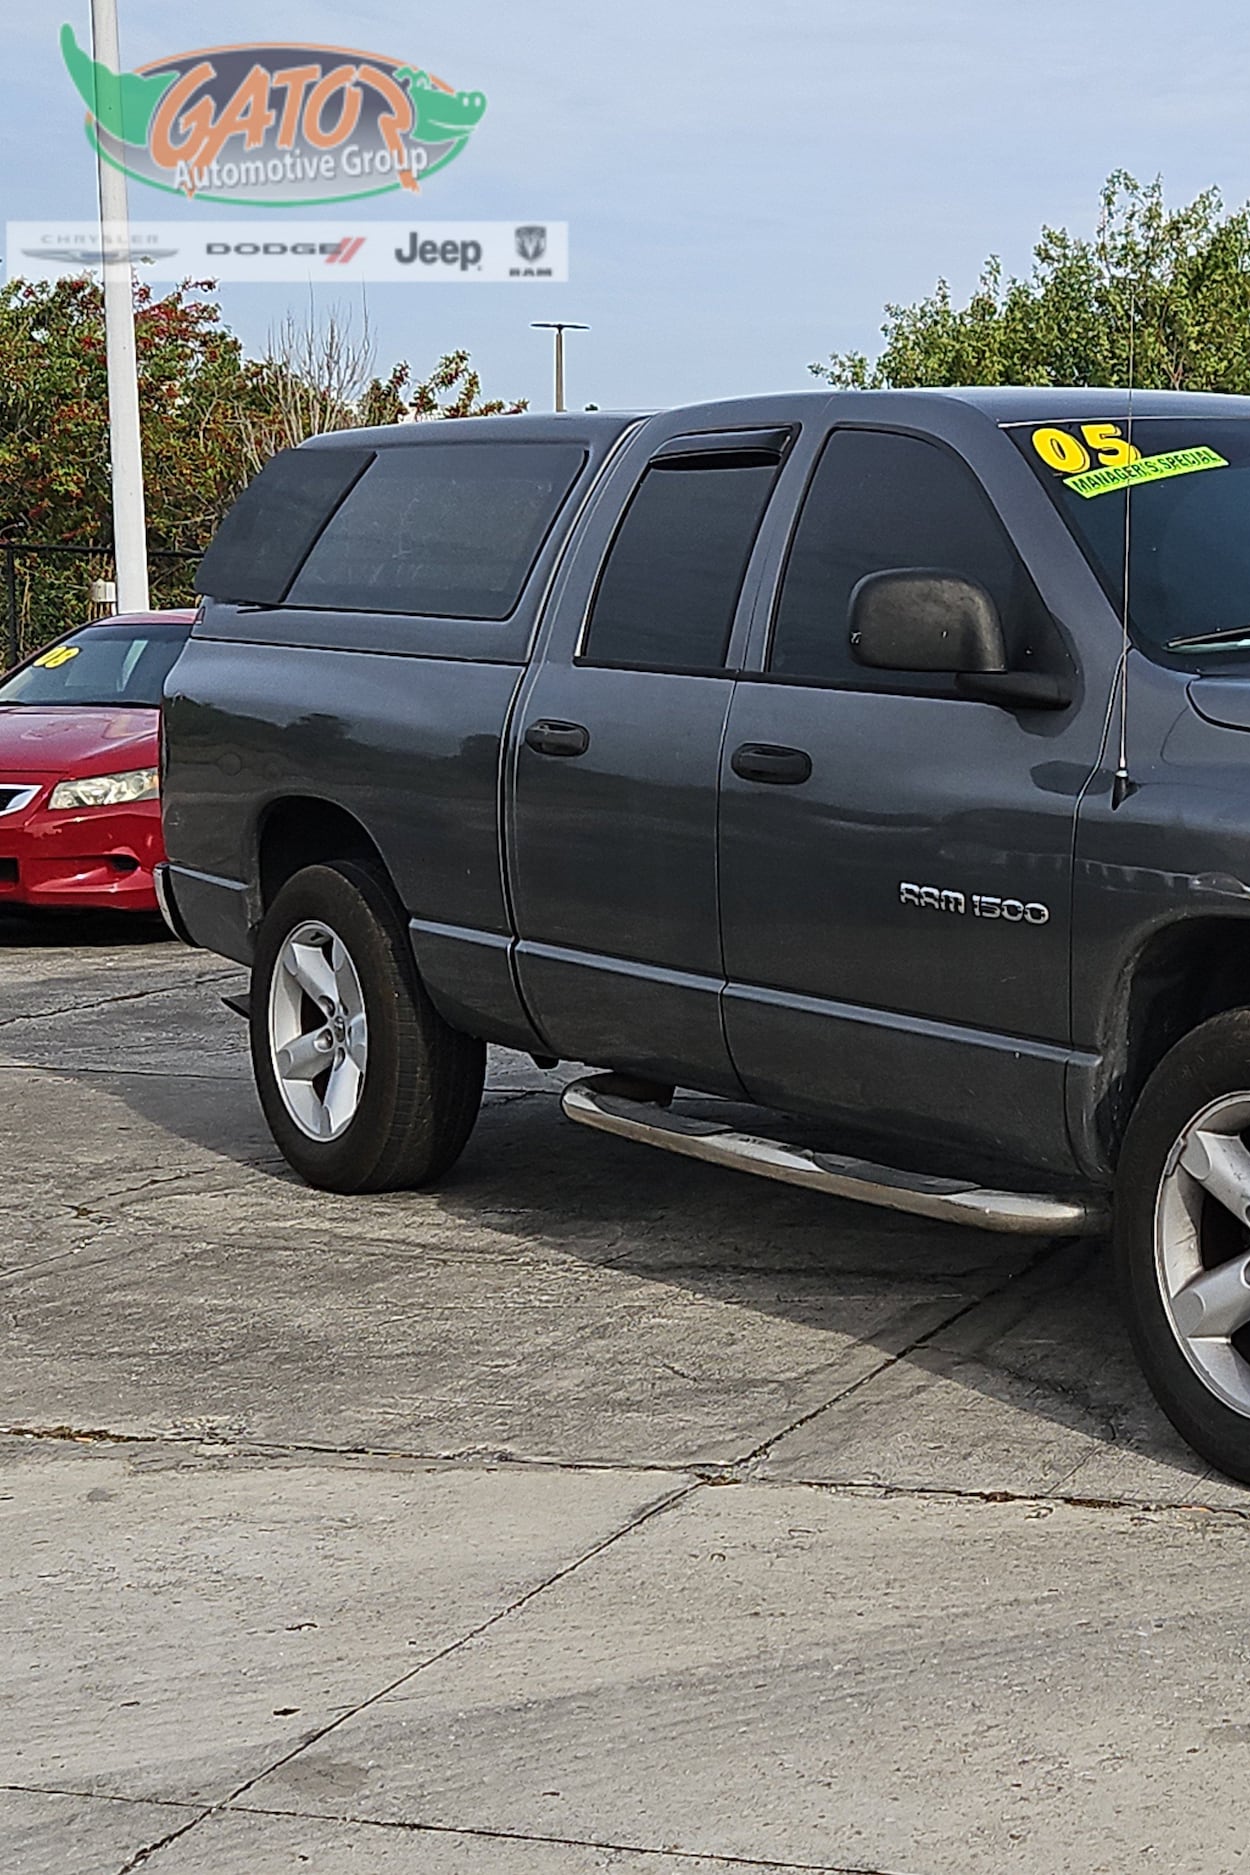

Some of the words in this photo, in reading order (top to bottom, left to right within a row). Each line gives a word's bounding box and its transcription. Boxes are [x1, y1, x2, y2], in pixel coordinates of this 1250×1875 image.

[1031, 423, 1142, 474] 05
[1071, 461, 1160, 493] MANAGER'S
[1157, 450, 1222, 471] SPECIAL
[900, 881, 966, 915] RAM
[971, 893, 1050, 925] 1500
